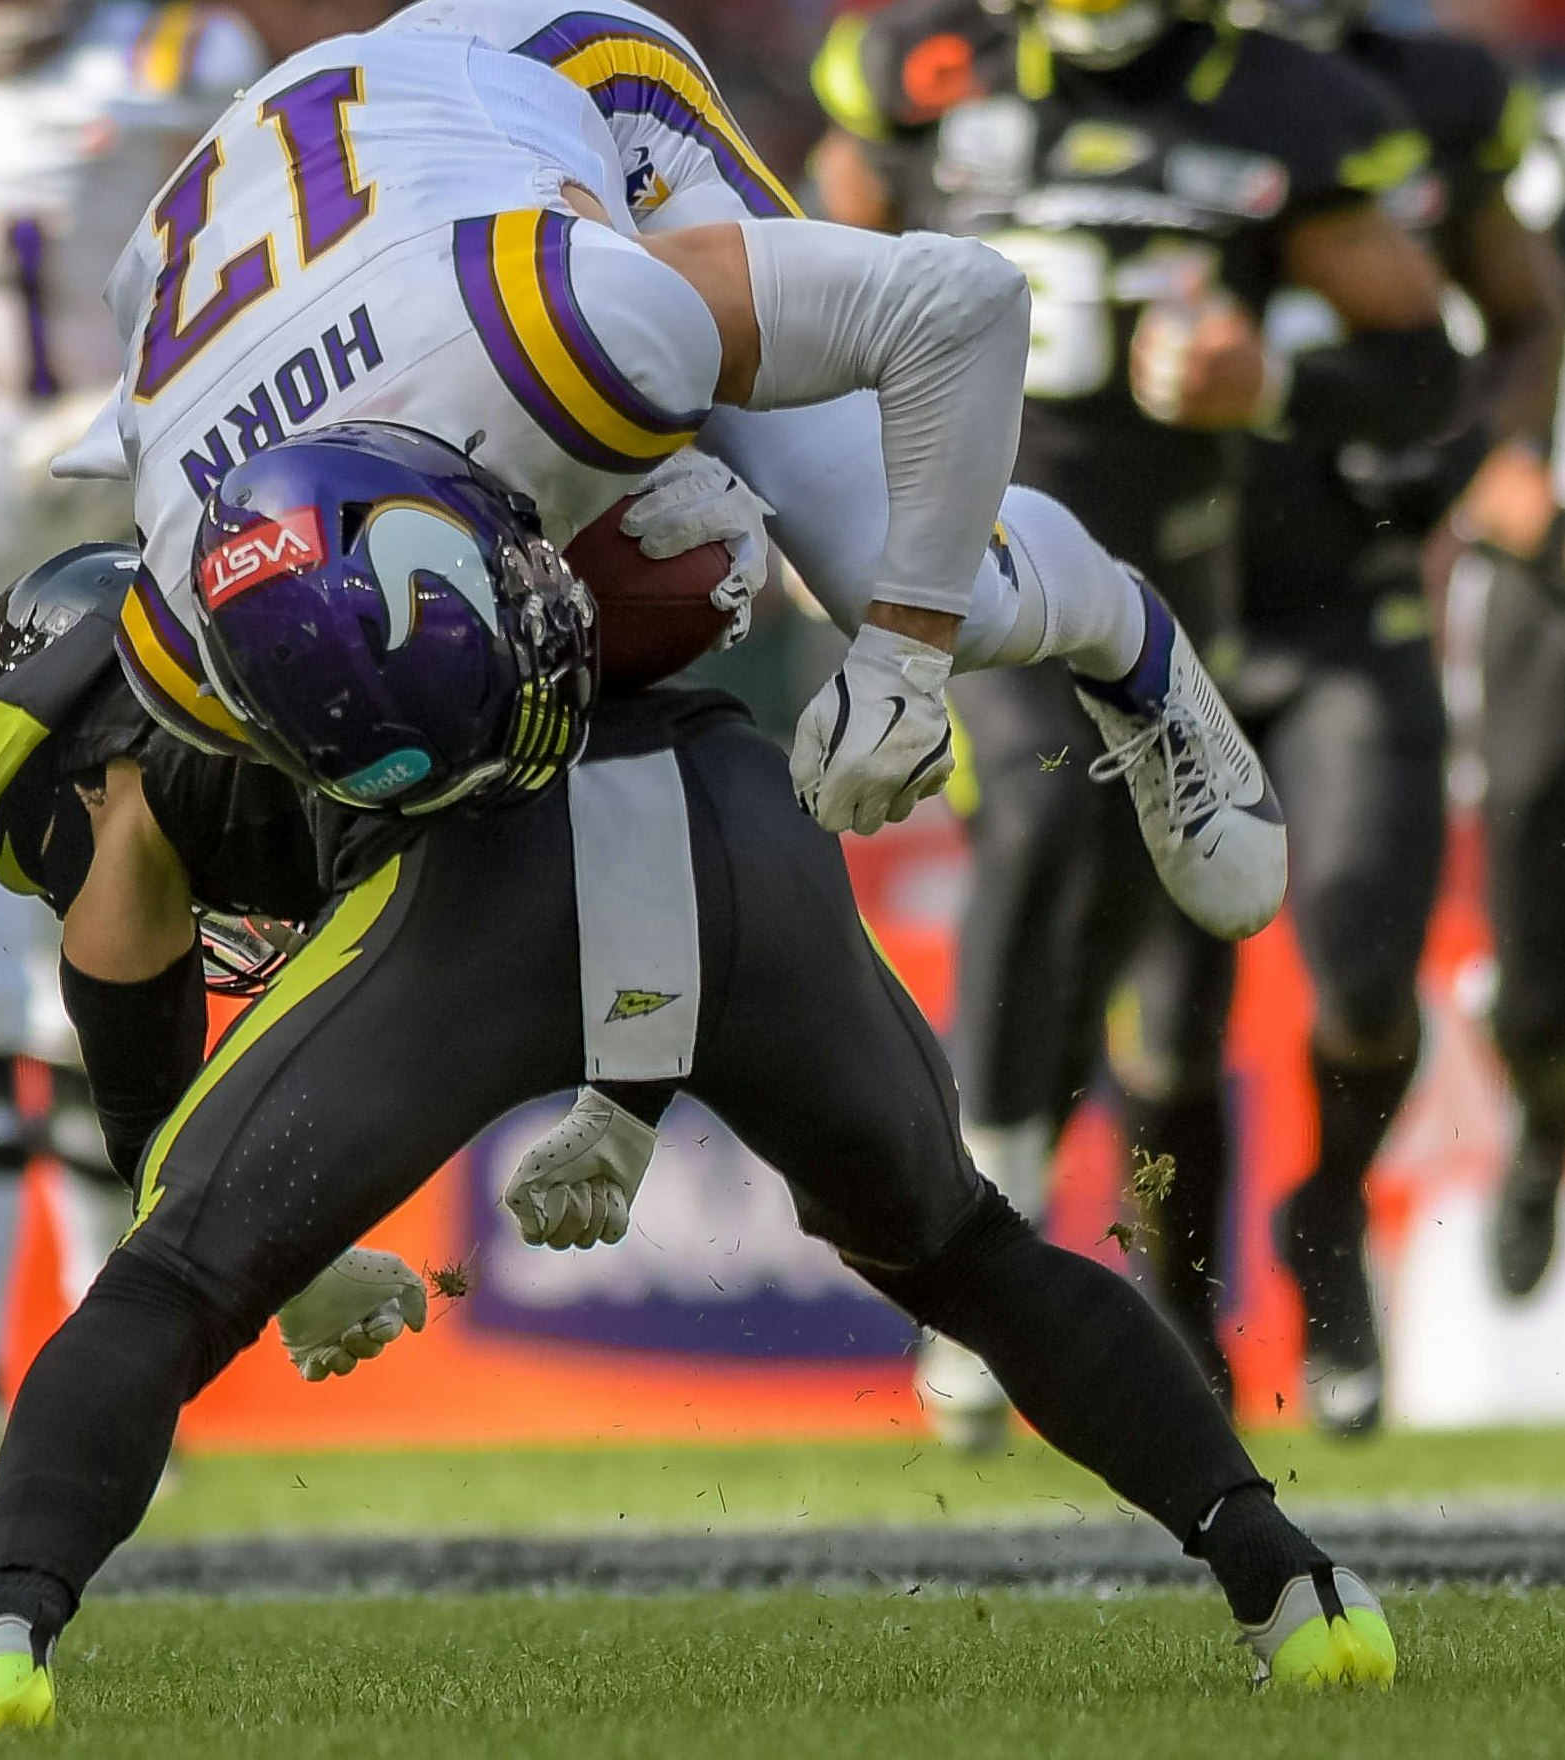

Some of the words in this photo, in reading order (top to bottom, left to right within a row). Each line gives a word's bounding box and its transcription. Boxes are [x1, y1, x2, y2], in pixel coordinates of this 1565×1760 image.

[132, 65, 378, 404] 17
[179, 302, 385, 507] HORN
[210, 528, 312, 597] VAST
